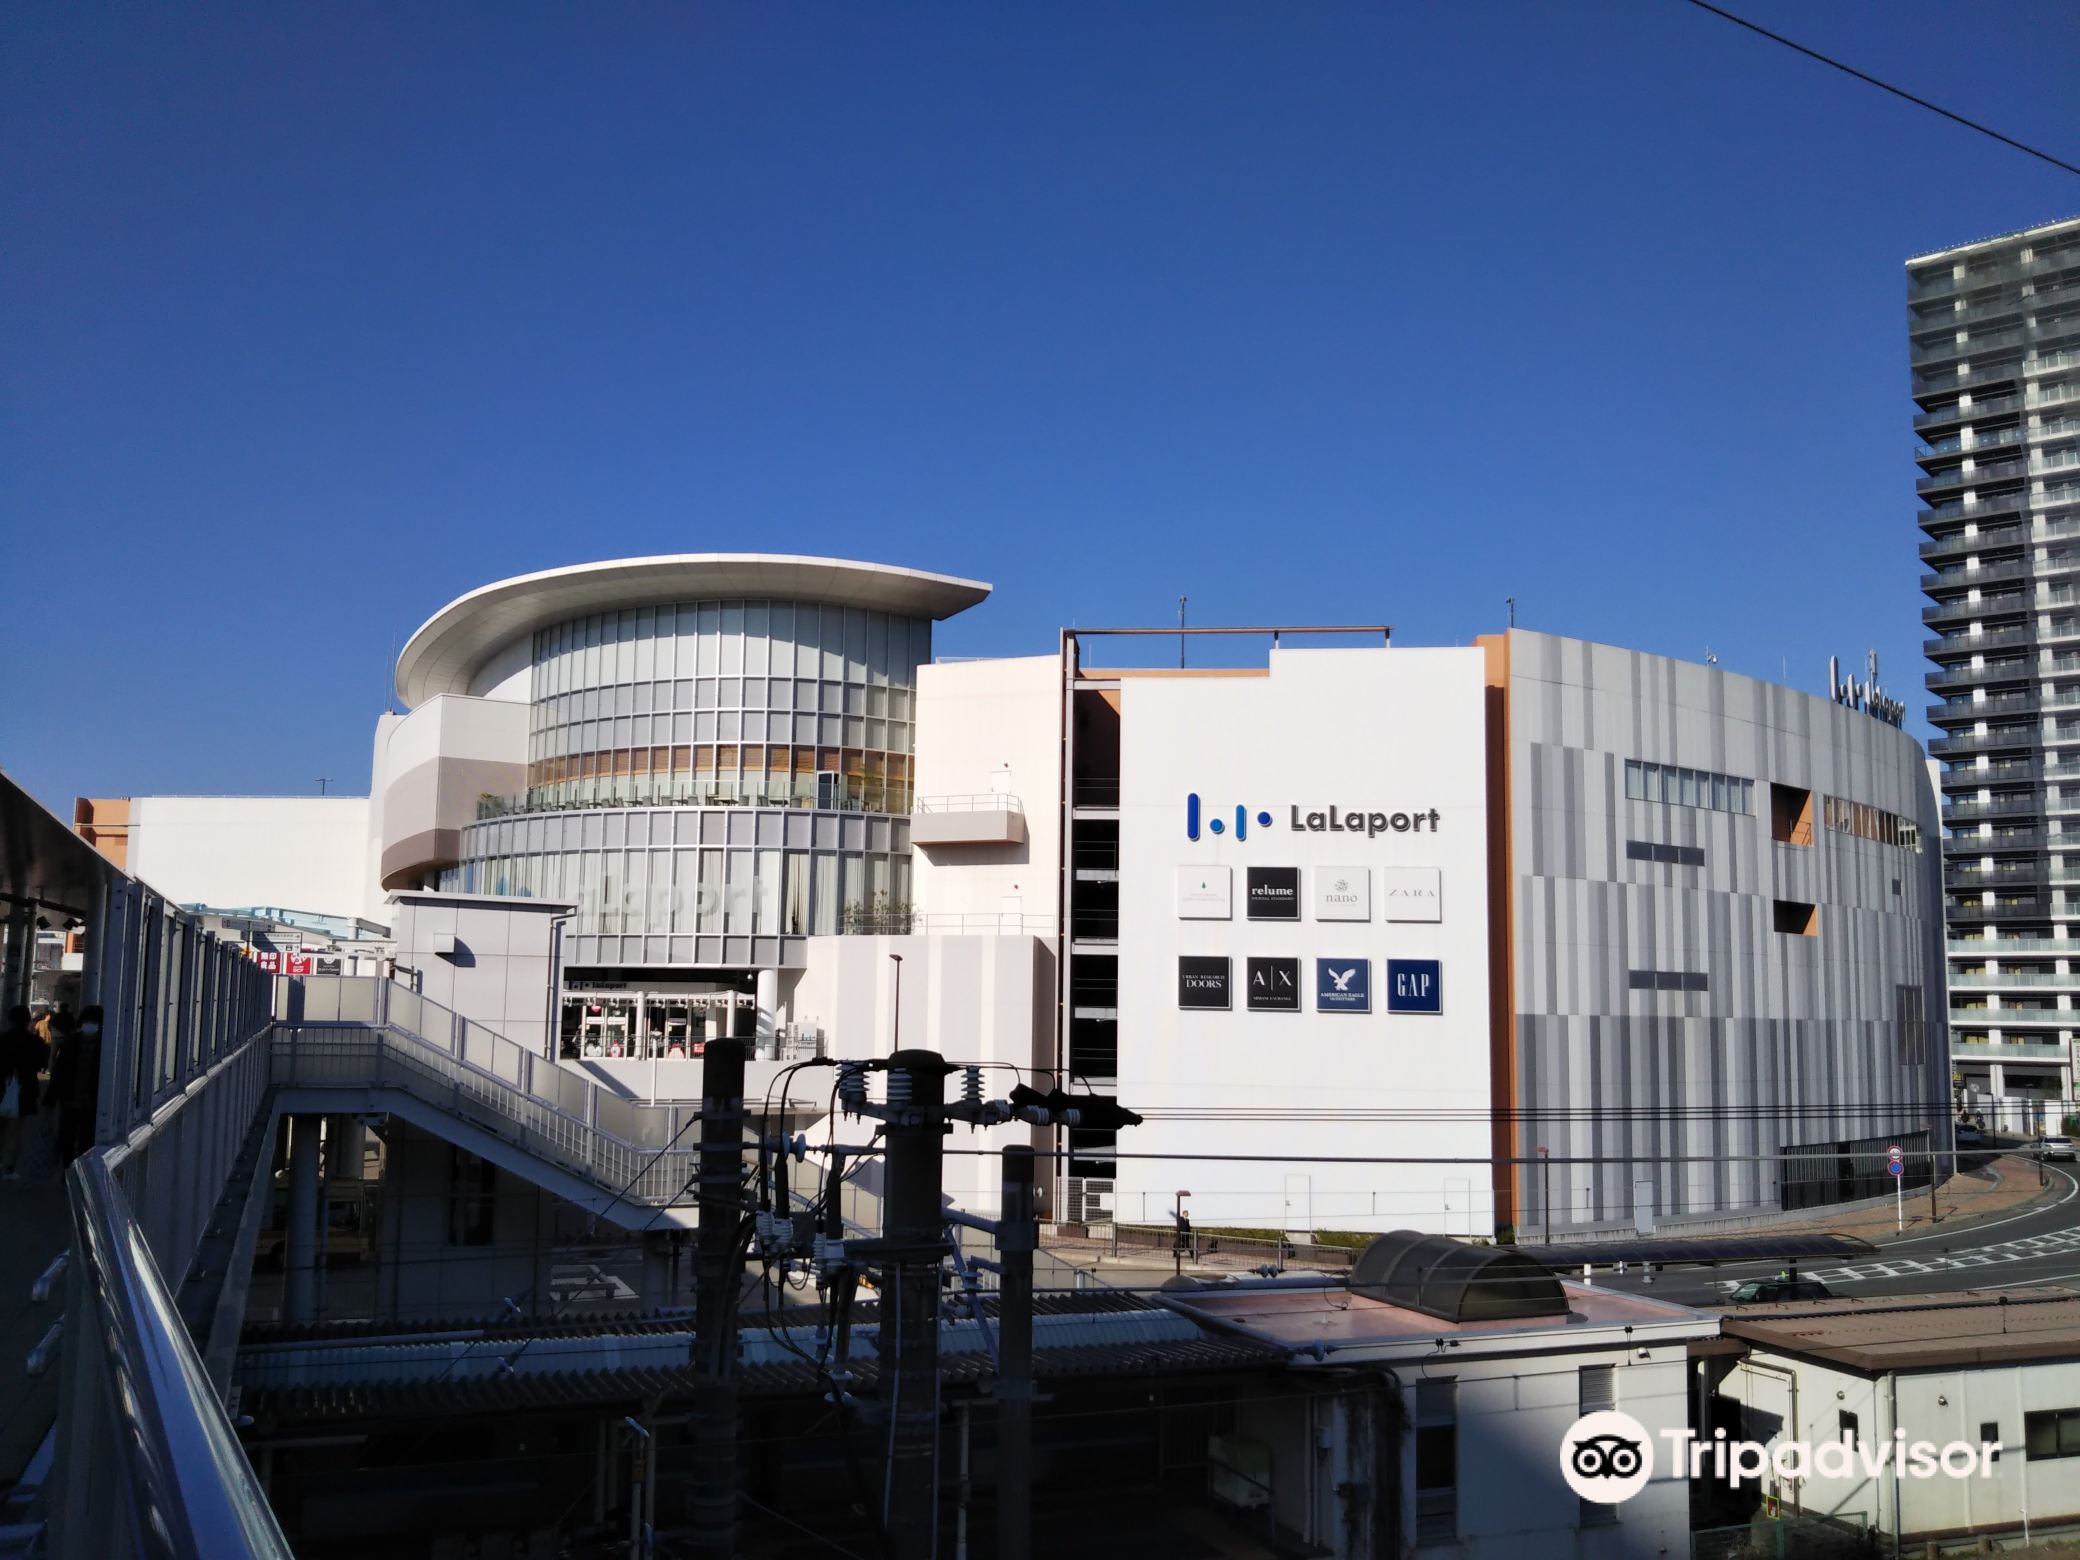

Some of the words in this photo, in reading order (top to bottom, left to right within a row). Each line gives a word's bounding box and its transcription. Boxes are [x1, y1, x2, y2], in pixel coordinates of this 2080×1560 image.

[1290, 804, 1440, 838] LaLaport
[1251, 884, 1294, 896] relume
[1389, 889, 1435, 897] ZARA
[1325, 894, 1358, 903] nano
[1186, 980, 1222, 988] DOORS
[1397, 973, 1430, 997] GAP
